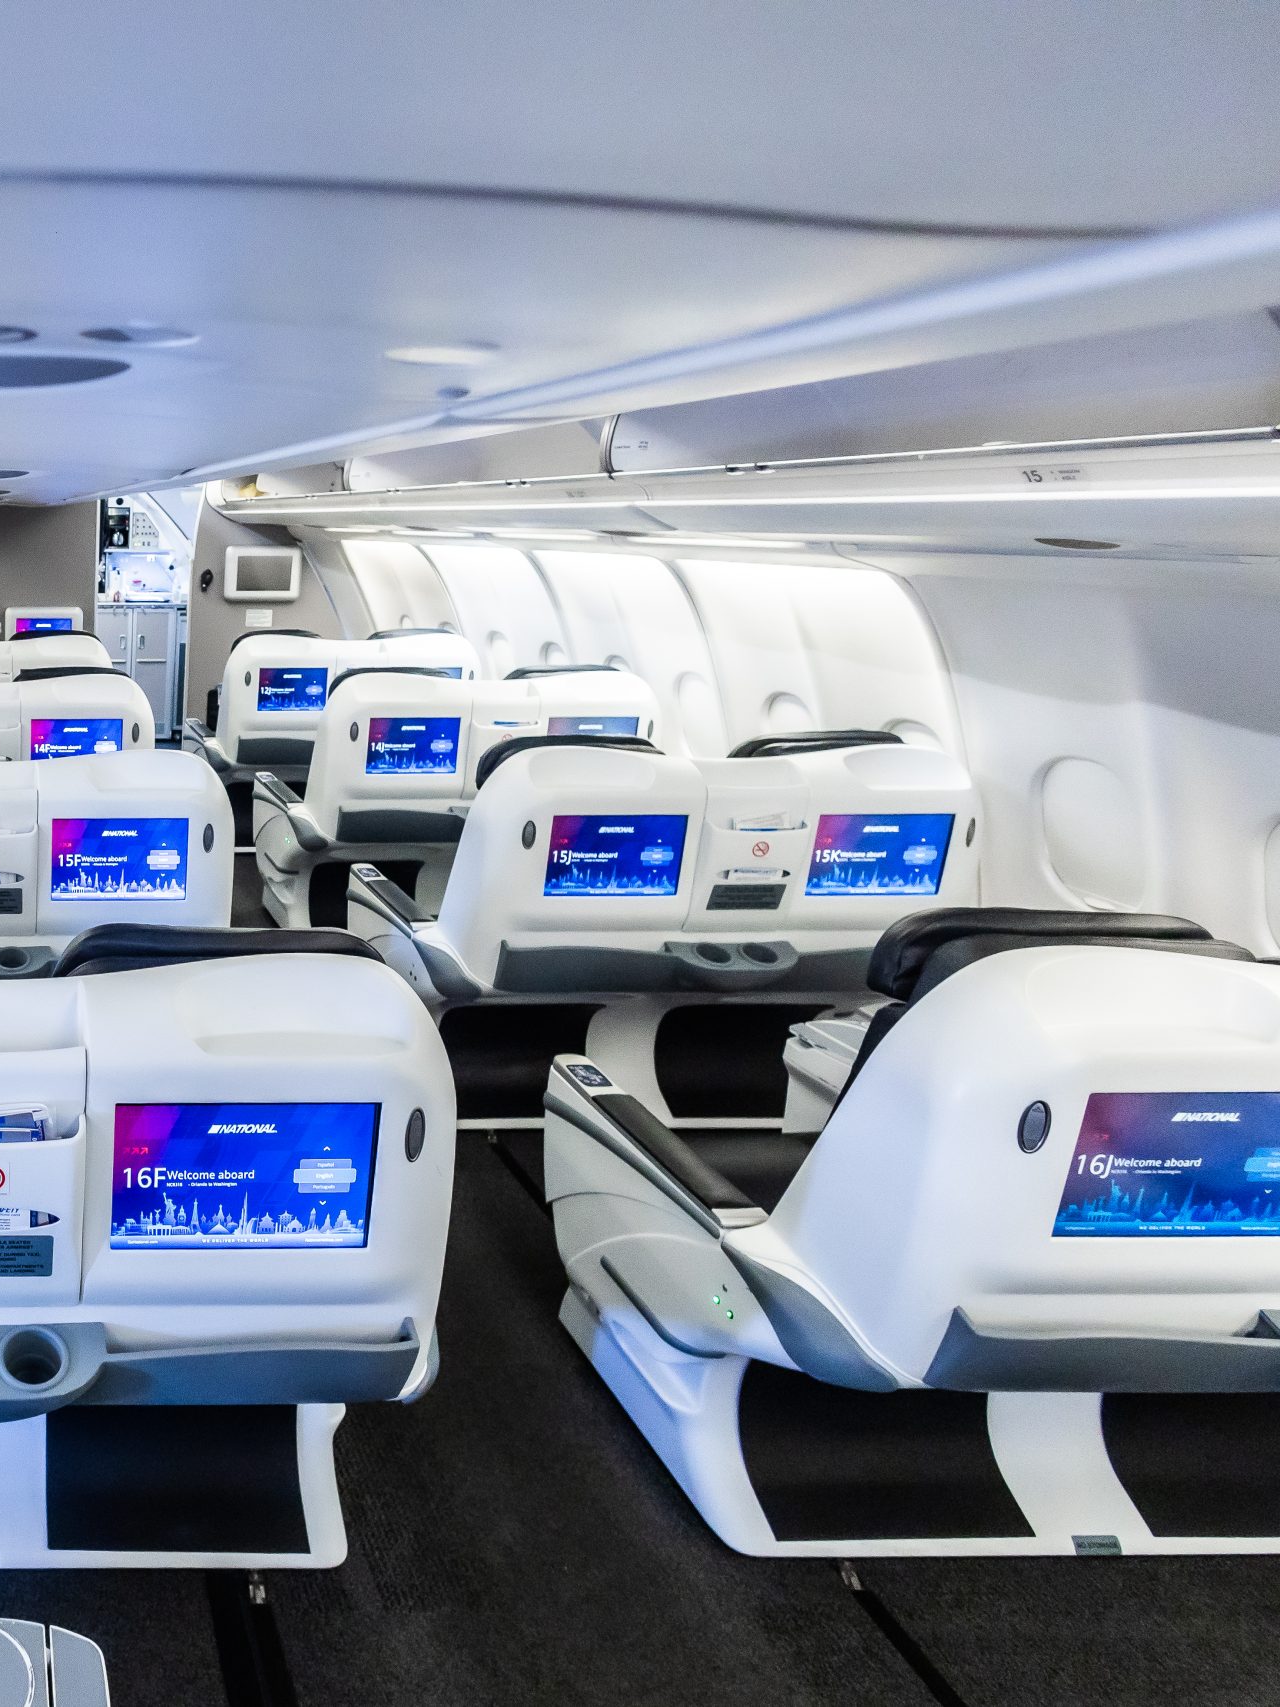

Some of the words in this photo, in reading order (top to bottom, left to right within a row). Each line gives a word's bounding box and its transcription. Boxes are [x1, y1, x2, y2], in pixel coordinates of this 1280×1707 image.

[1023, 470, 1043, 482] 15
[34, 744, 51, 753] 14F
[58, 854, 82, 867] 15F
[552, 850, 573, 865] 15J
[598, 851, 618, 859] aboard
[815, 850, 841, 862] 15K
[1183, 1113, 1240, 1122] NATIONAL
[219, 1124, 278, 1134] NATIONAL
[1077, 1154, 1114, 1179] 16J
[1113, 1158, 1161, 1167] Welcome
[1164, 1158, 1202, 1167] aboard
[123, 1167, 167, 1188] 16F
[166, 1170, 215, 1180] Welcome
[218, 1170, 255, 1180] aboard
